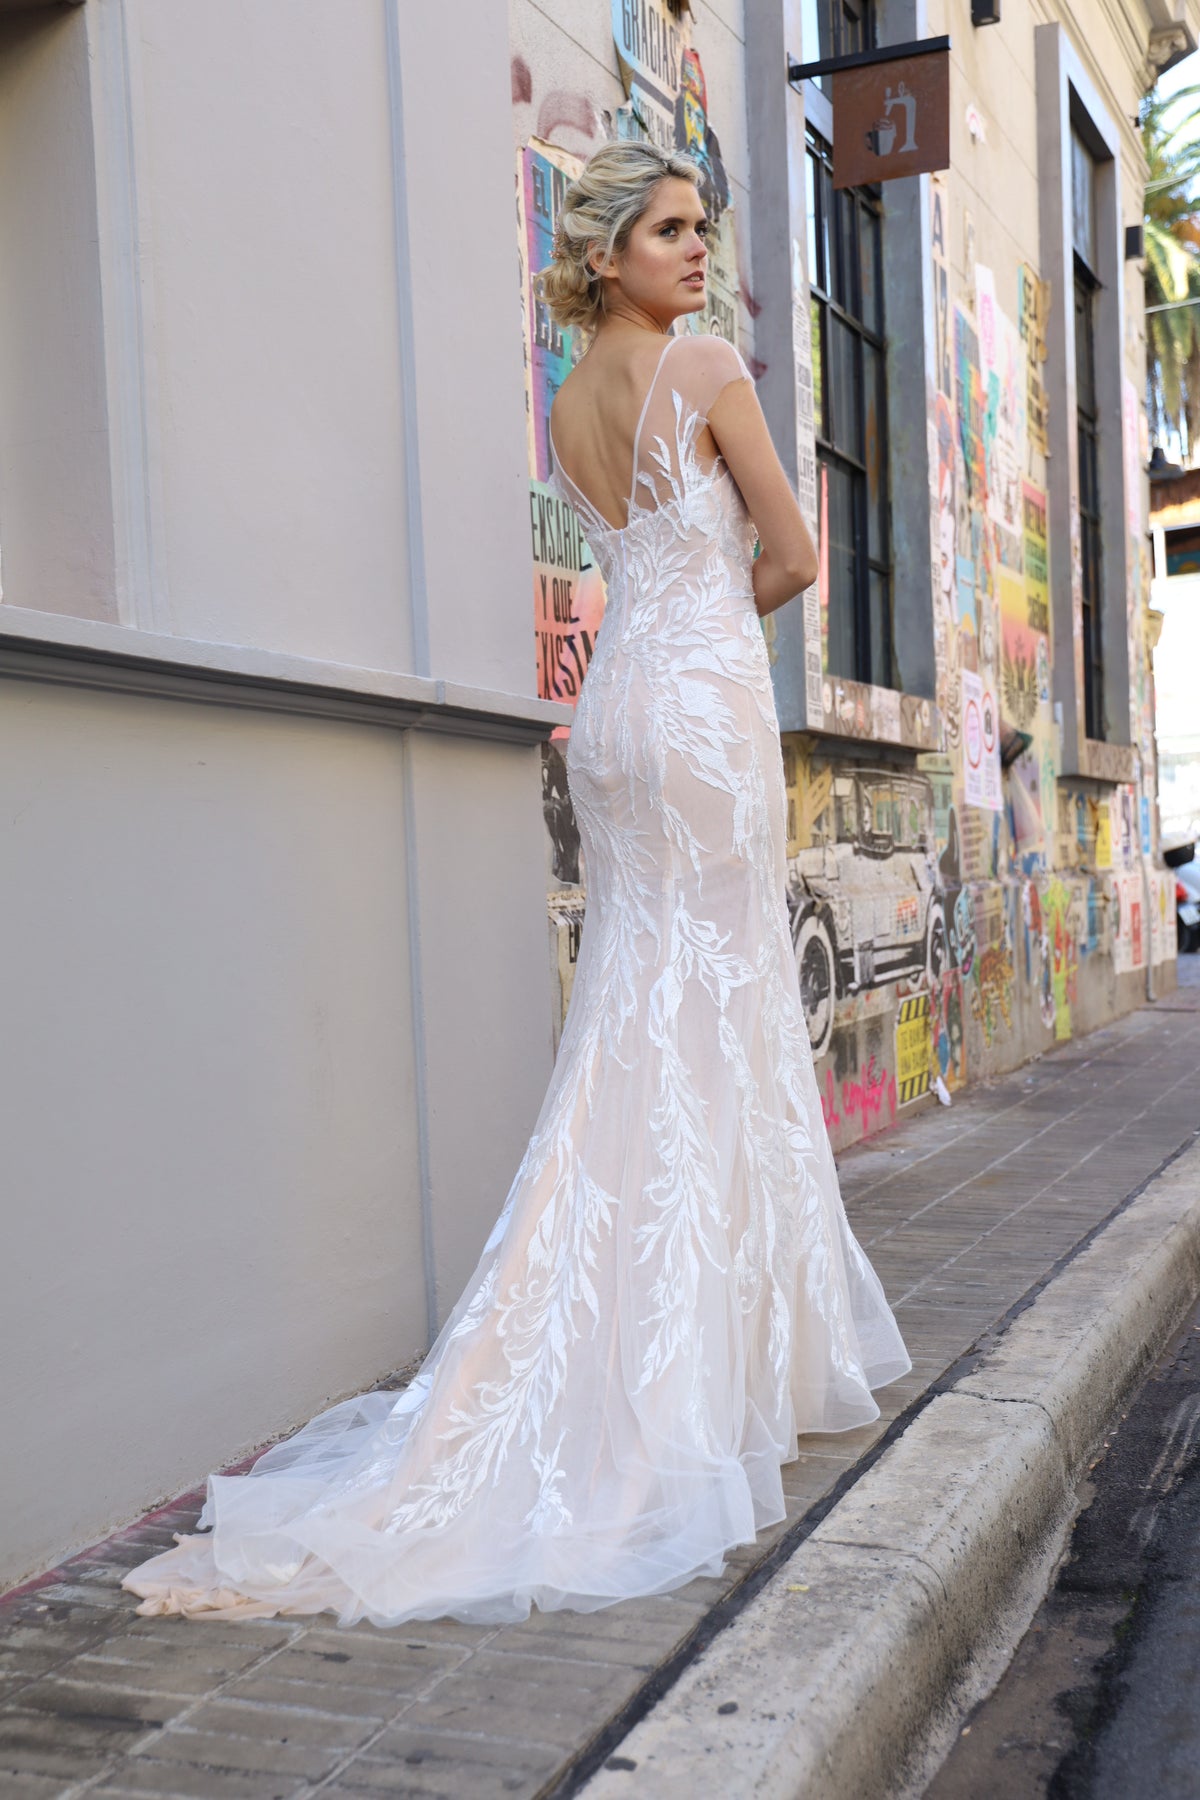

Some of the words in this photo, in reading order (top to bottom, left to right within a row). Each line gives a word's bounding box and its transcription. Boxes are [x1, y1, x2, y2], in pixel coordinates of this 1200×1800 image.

[622, 0, 677, 92] GRACIAS
[532, 164, 549, 219] EL
[540, 574, 547, 620] Y
[552, 577, 580, 624] QUE
[535, 630, 599, 700] XIST
